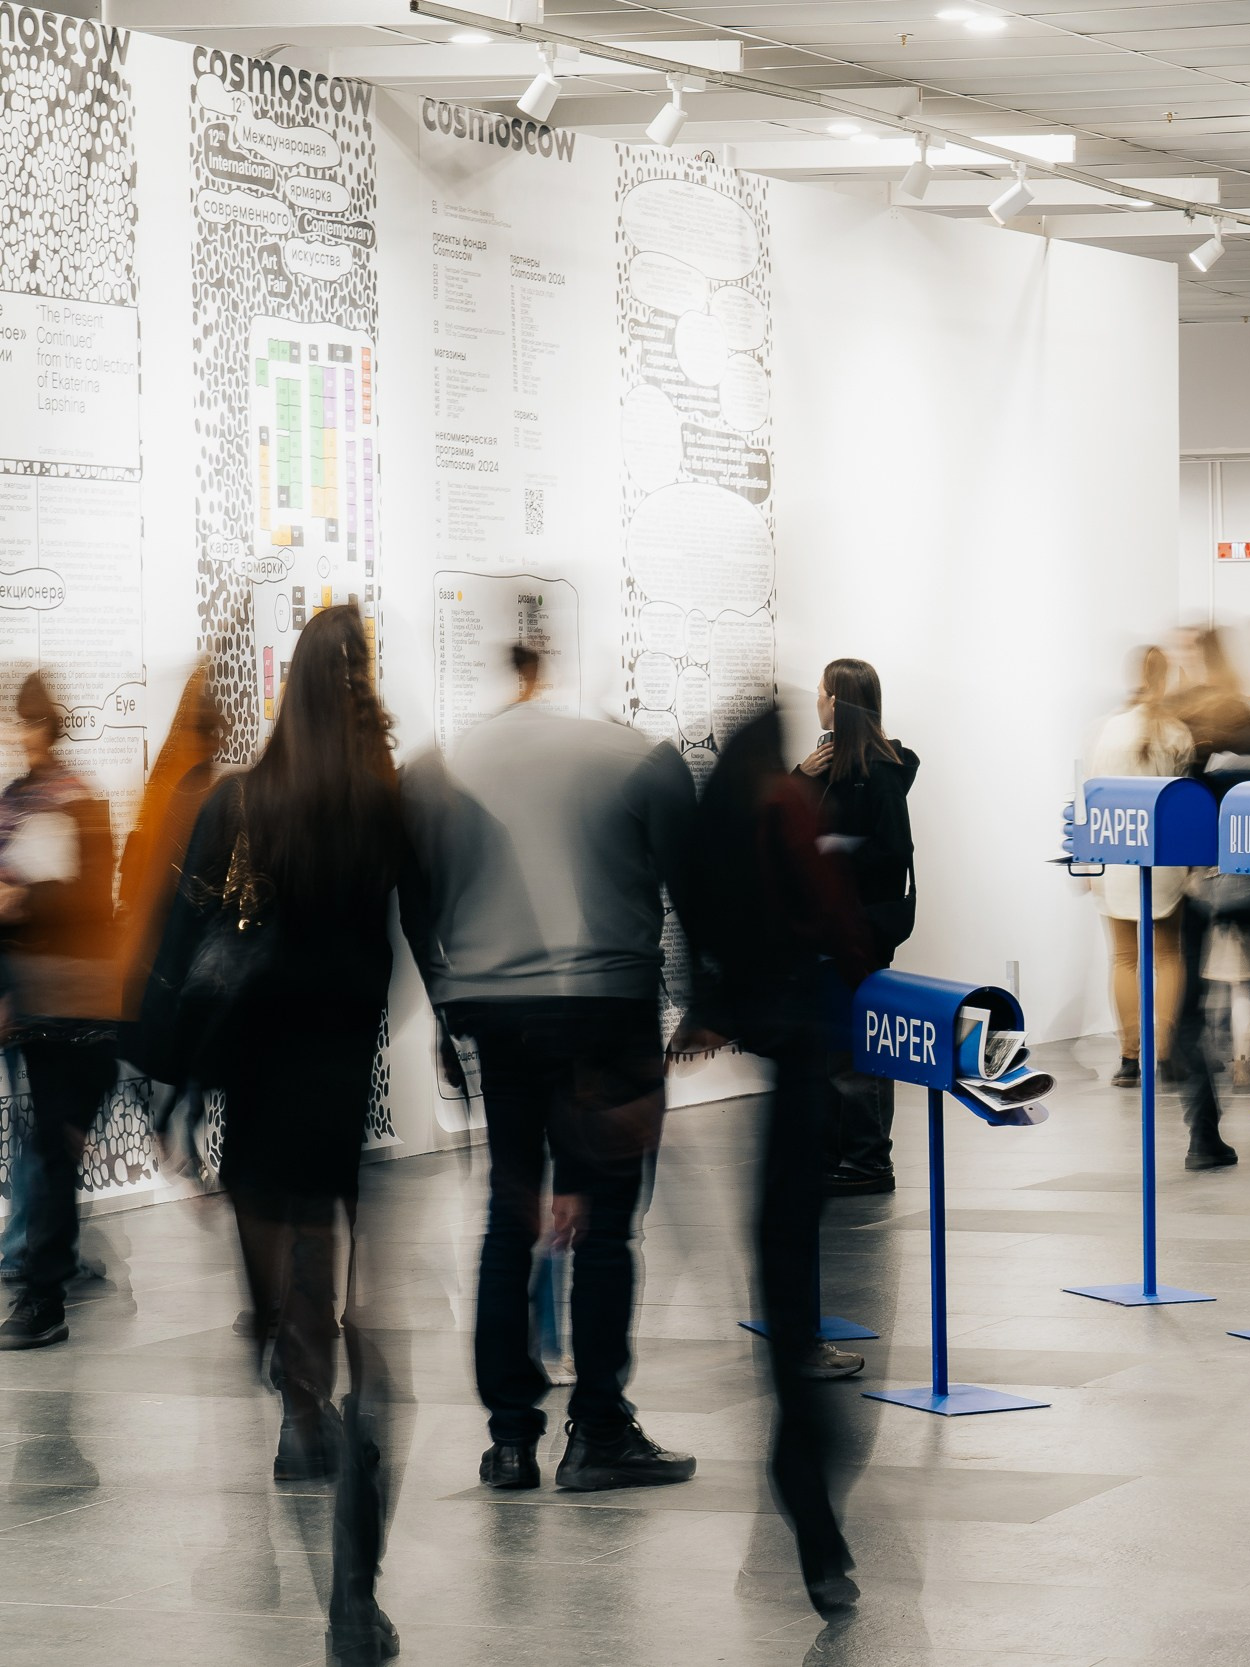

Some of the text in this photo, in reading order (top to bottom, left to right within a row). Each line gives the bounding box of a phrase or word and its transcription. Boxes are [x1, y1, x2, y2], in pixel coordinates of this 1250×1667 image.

[193, 45, 372, 118] cosmoscow
[422, 97, 576, 163] cosmoscow
[242, 126, 327, 158] Международная
[208, 151, 273, 180] International
[290, 184, 332, 206] ярмарка
[203, 200, 289, 227] современного
[303, 213, 373, 246] Contemporary
[433, 243, 472, 261] Cosmoscow
[462, 235, 487, 251] фонда
[261, 252, 278, 270] Art
[292, 249, 341, 267] искусства
[267, 275, 288, 293] Fair
[510, 265, 566, 285] Cosmoscow 2024
[64, 308, 104, 328] Present
[37, 348, 135, 374] from the collection
[37, 371, 100, 393] of Ekaterina
[38, 393, 85, 415] Lapshina
[435, 431, 498, 446] некоммерческая
[435, 445, 474, 458] программа
[435, 456, 499, 472] Cosmoscow 2024
[210, 541, 240, 559] карта
[241, 560, 284, 579] ярмарки
[116, 695, 136, 716] Eye
[1090, 807, 1149, 847] PAPER
[866, 1010, 936, 1066] PAPER
